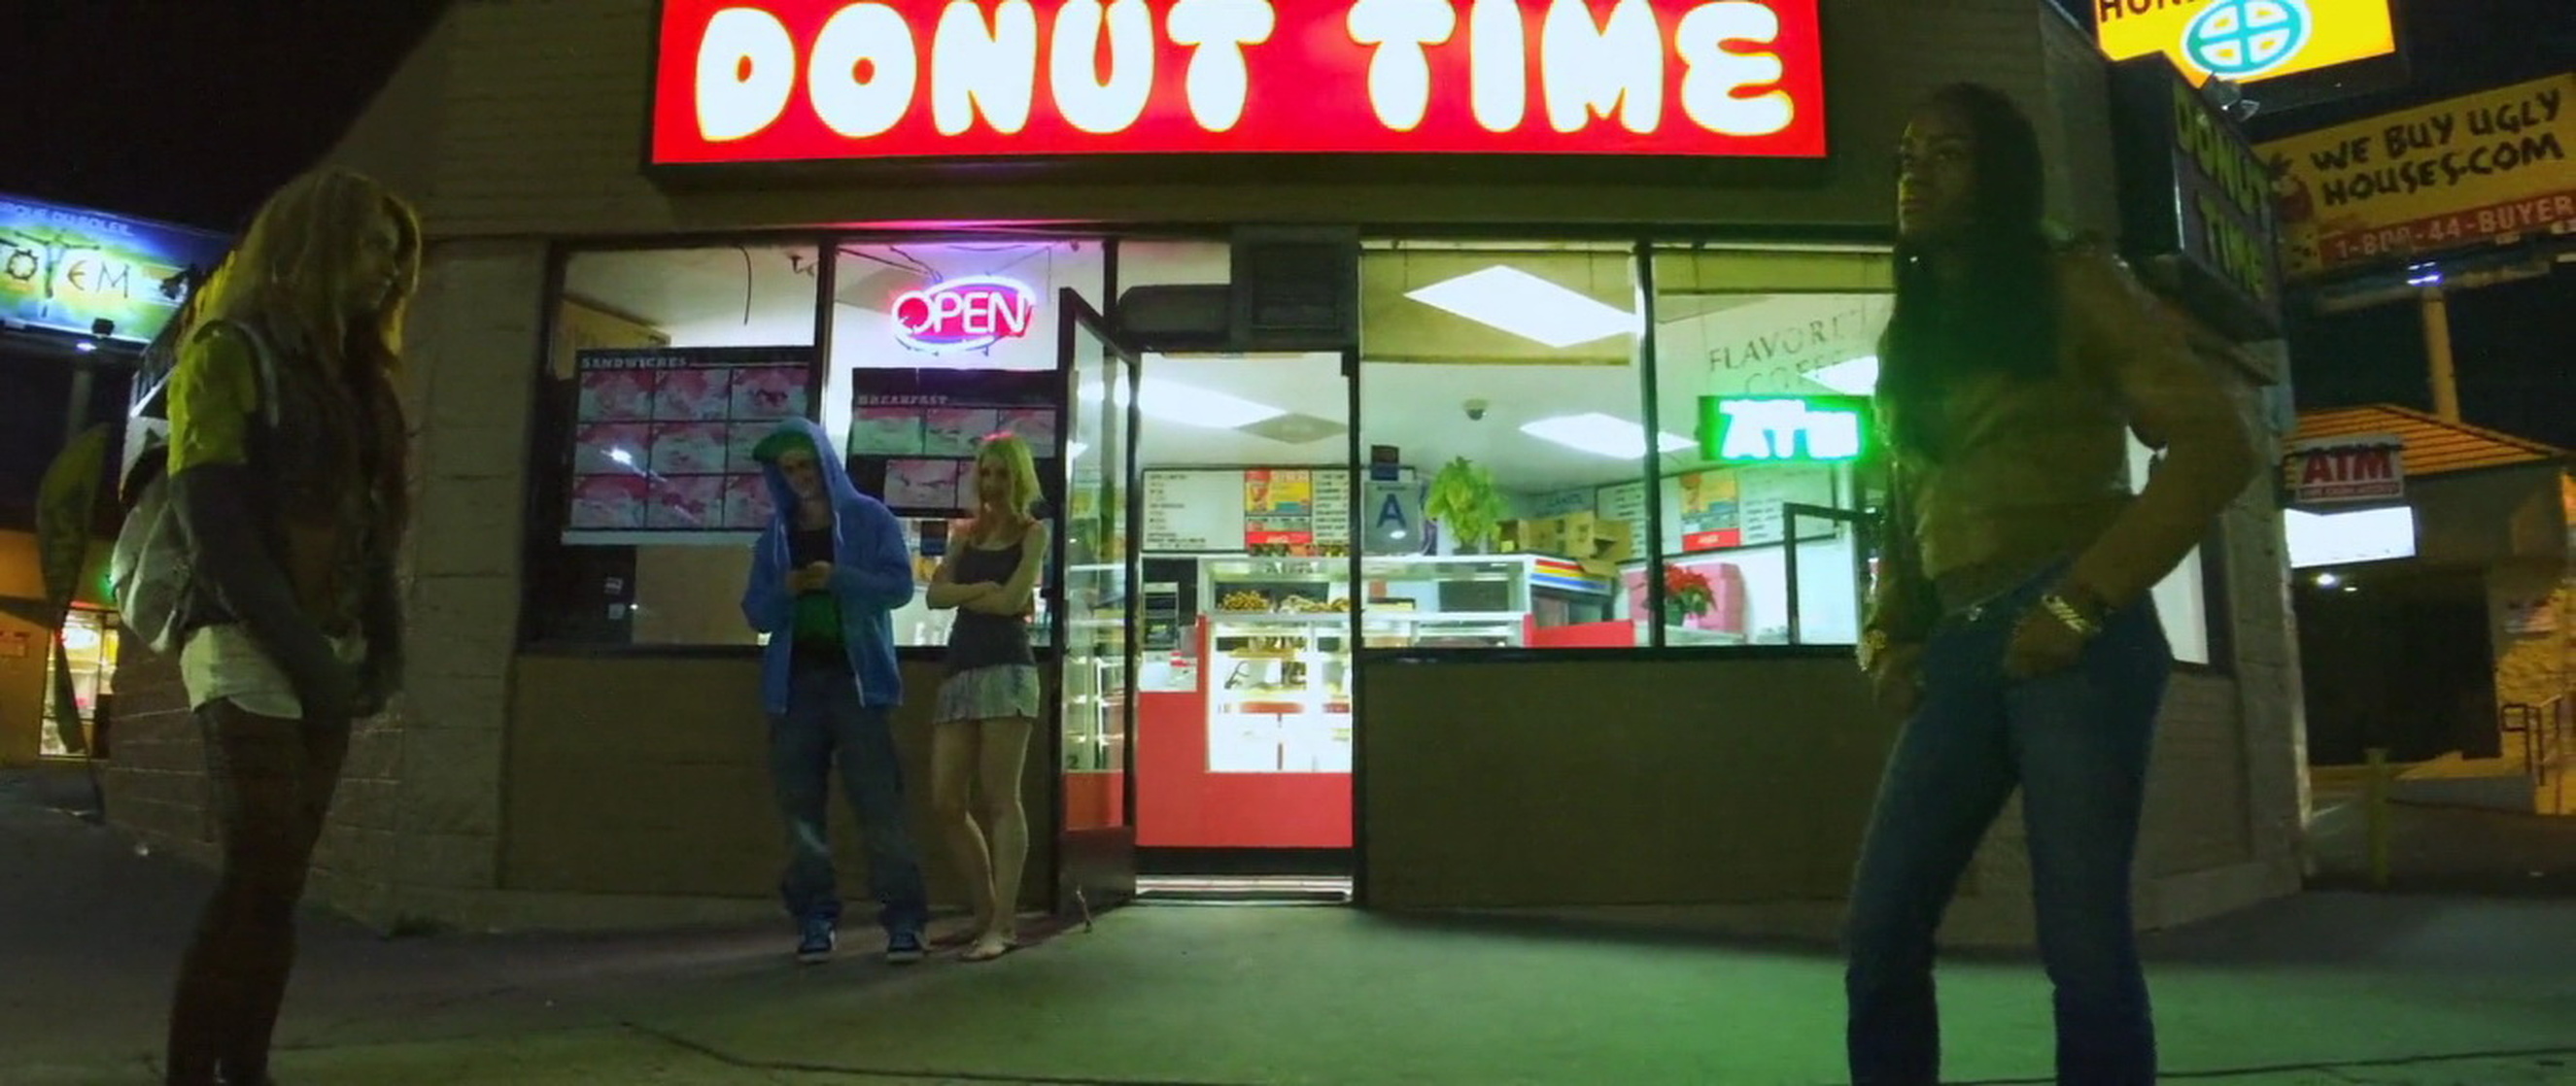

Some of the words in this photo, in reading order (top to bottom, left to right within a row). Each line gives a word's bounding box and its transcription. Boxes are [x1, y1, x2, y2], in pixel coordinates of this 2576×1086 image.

[695, 0, 1276, 142] DONUT
[1346, 0, 1795, 137] TIME
[2310, 137, 2371, 171] WE
[2384, 113, 2454, 160] BUY
[2467, 87, 2560, 136] UGLY
[0, 231, 131, 299] OTEM
[891, 289, 1026, 335] OPEN
[581, 356, 689, 368] SANDWICHES
[2302, 448, 2393, 485] ATM
[1376, 493, 1407, 530] A
